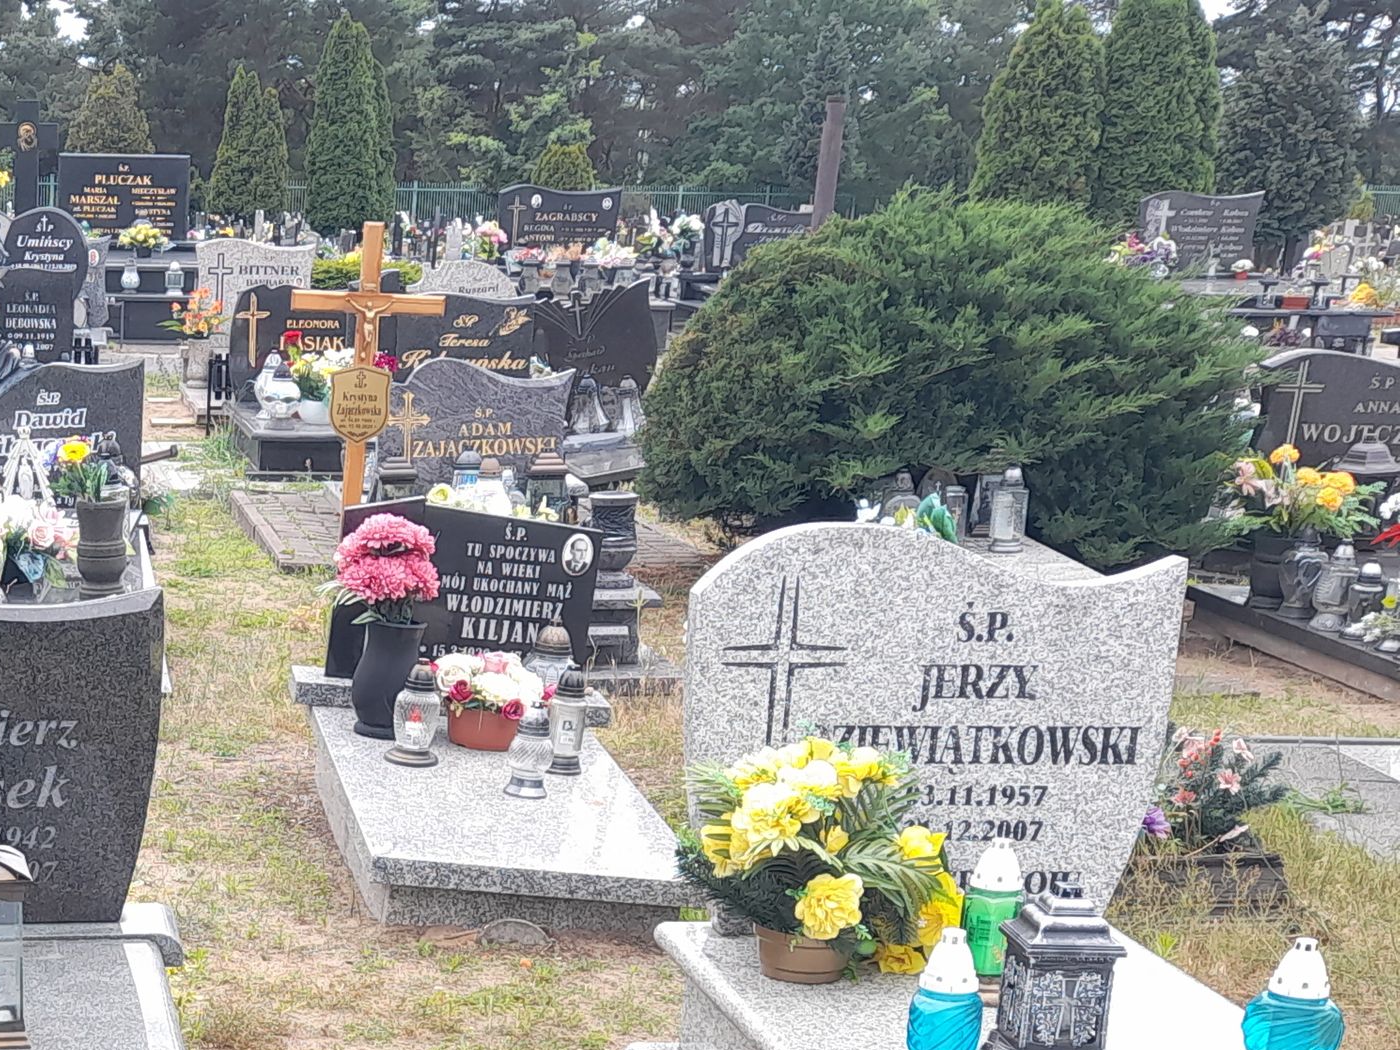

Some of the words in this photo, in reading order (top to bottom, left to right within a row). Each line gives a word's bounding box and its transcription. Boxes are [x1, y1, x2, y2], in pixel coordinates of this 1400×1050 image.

[94, 174, 152, 186] PLUCZAK
[83, 186, 108, 194] MARIA
[534, 211, 599, 222] ZAGRABSCY
[523, 224, 555, 232] REGINA
[16, 235, 74, 251] Umińscy
[523, 234, 555, 242] ANTONI
[24, 251, 65, 263] Krystyna
[239, 265, 300, 276] BITTNER
[458, 285, 499, 294] Ryszard
[6, 303, 57, 314] LEOKADIA
[5, 318, 57, 329] DĘBOWSKA
[286, 319, 340, 329] ELEONORA
[438, 333, 491, 348] Teresa
[343, 392, 378, 405] Krystyna
[474, 407, 497, 419] Ś.P.
[1352, 400, 1400, 414] ANNA
[12, 407, 87, 430] Dawid
[458, 422, 513, 436] ADAM
[505, 523, 528, 541] Ś.P.
[467, 543, 482, 557] TU
[489, 544, 557, 563] SPOCZYWA
[477, 561, 493, 575] NA
[502, 562, 542, 579] WIEKI
[441, 572, 466, 590] MÓJ
[473, 577, 541, 596] UKOCHANY
[547, 581, 573, 600] MĄŻ
[446, 594, 565, 619] WŁODZIMIERZ
[957, 601, 1014, 643] Ś.P.
[461, 616, 540, 645] KILJAN
[912, 664, 1039, 712] JERZY
